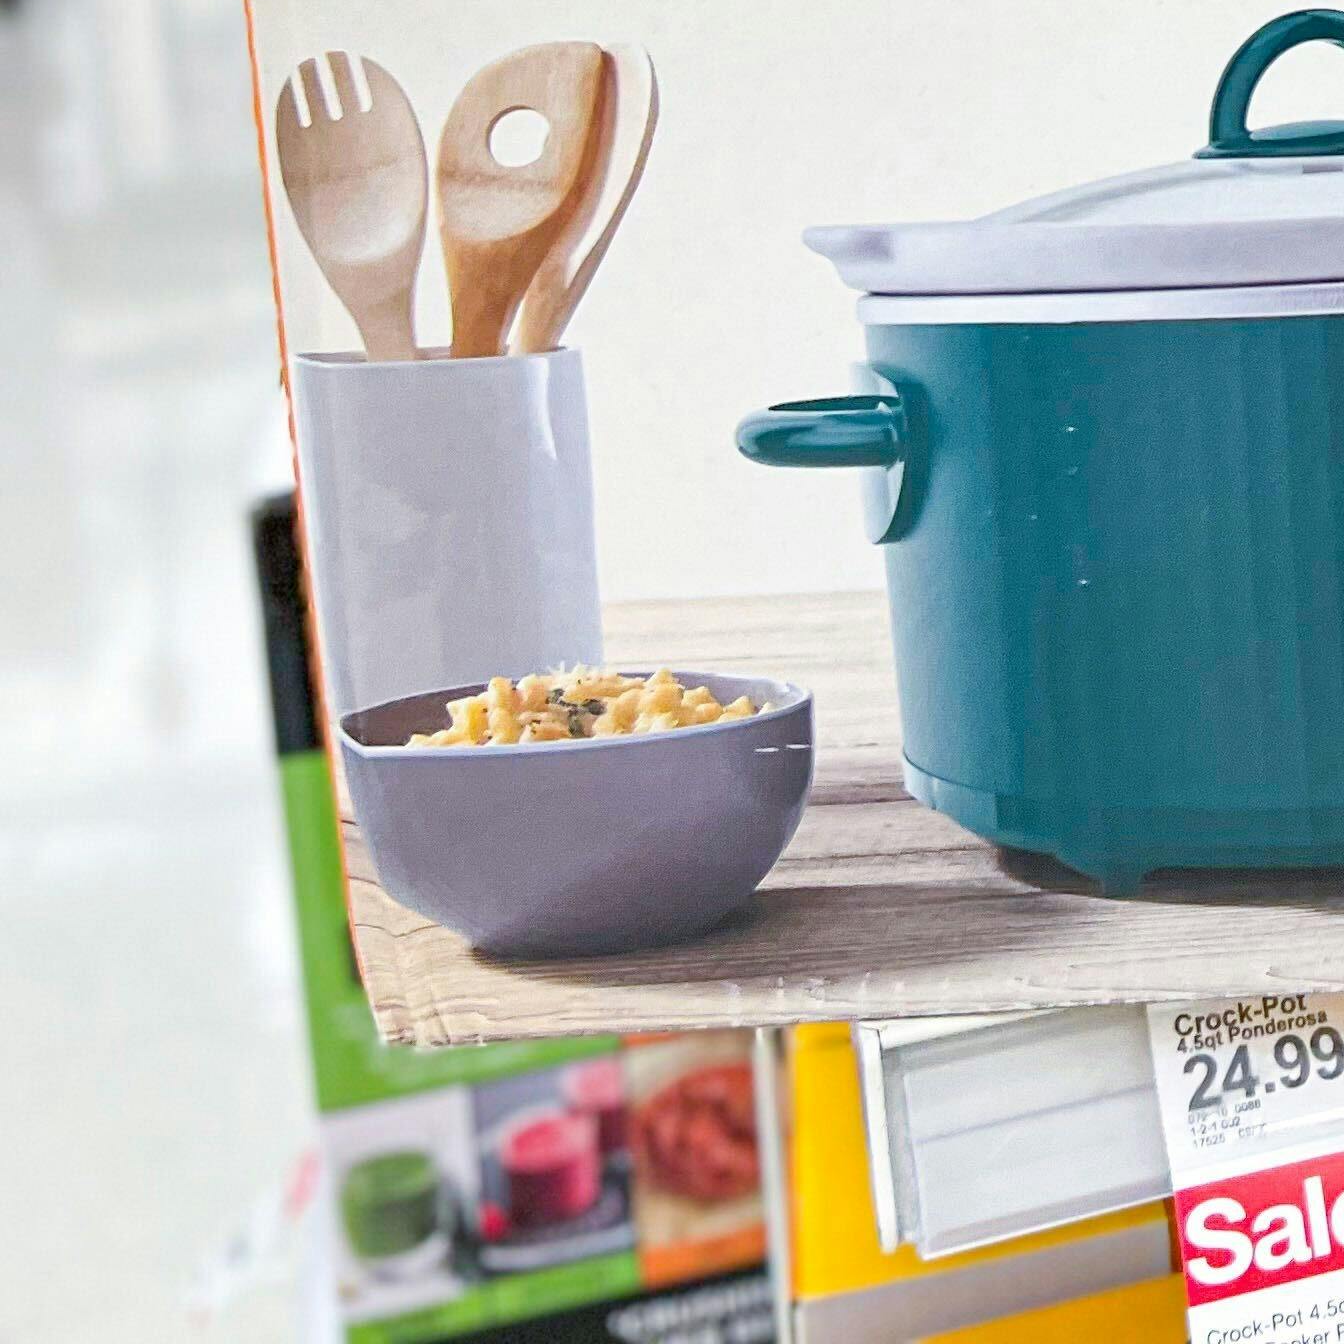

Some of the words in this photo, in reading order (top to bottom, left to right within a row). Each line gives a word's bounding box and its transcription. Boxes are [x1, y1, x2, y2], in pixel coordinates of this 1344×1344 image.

[1174, 994, 1307, 1036] Crock-Pot
[1177, 1031, 1224, 1054] 4.5qt
[1229, 1010, 1328, 1043] Ponderosa
[1207, 1309, 1304, 1344] Crock-Pot
